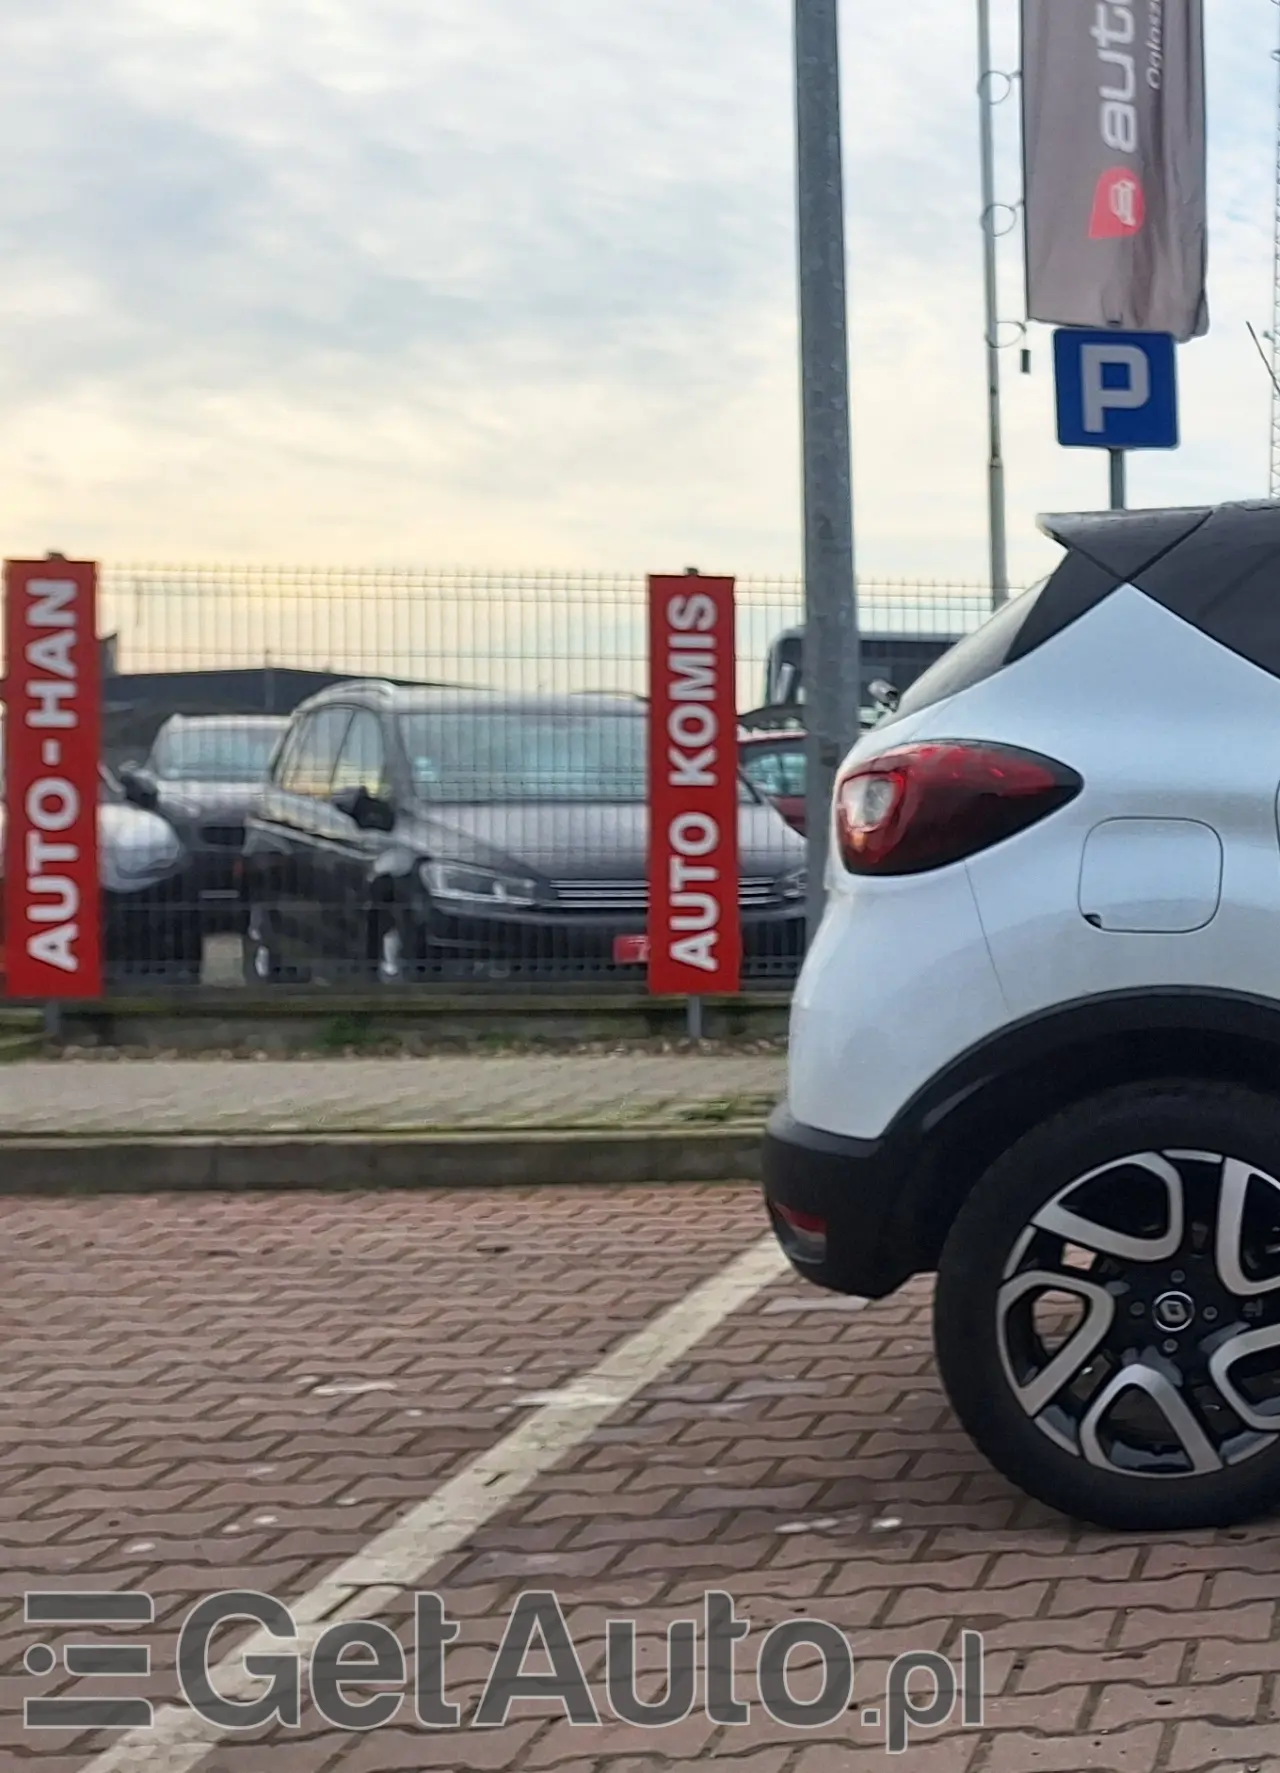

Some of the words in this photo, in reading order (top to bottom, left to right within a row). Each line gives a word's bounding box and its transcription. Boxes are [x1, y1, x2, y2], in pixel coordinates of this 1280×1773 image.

[1089, 0, 1136, 153] aut
[1079, 344, 1151, 433] P
[667, 593, 719, 787] KOMIS
[669, 811, 720, 972] AUTO
